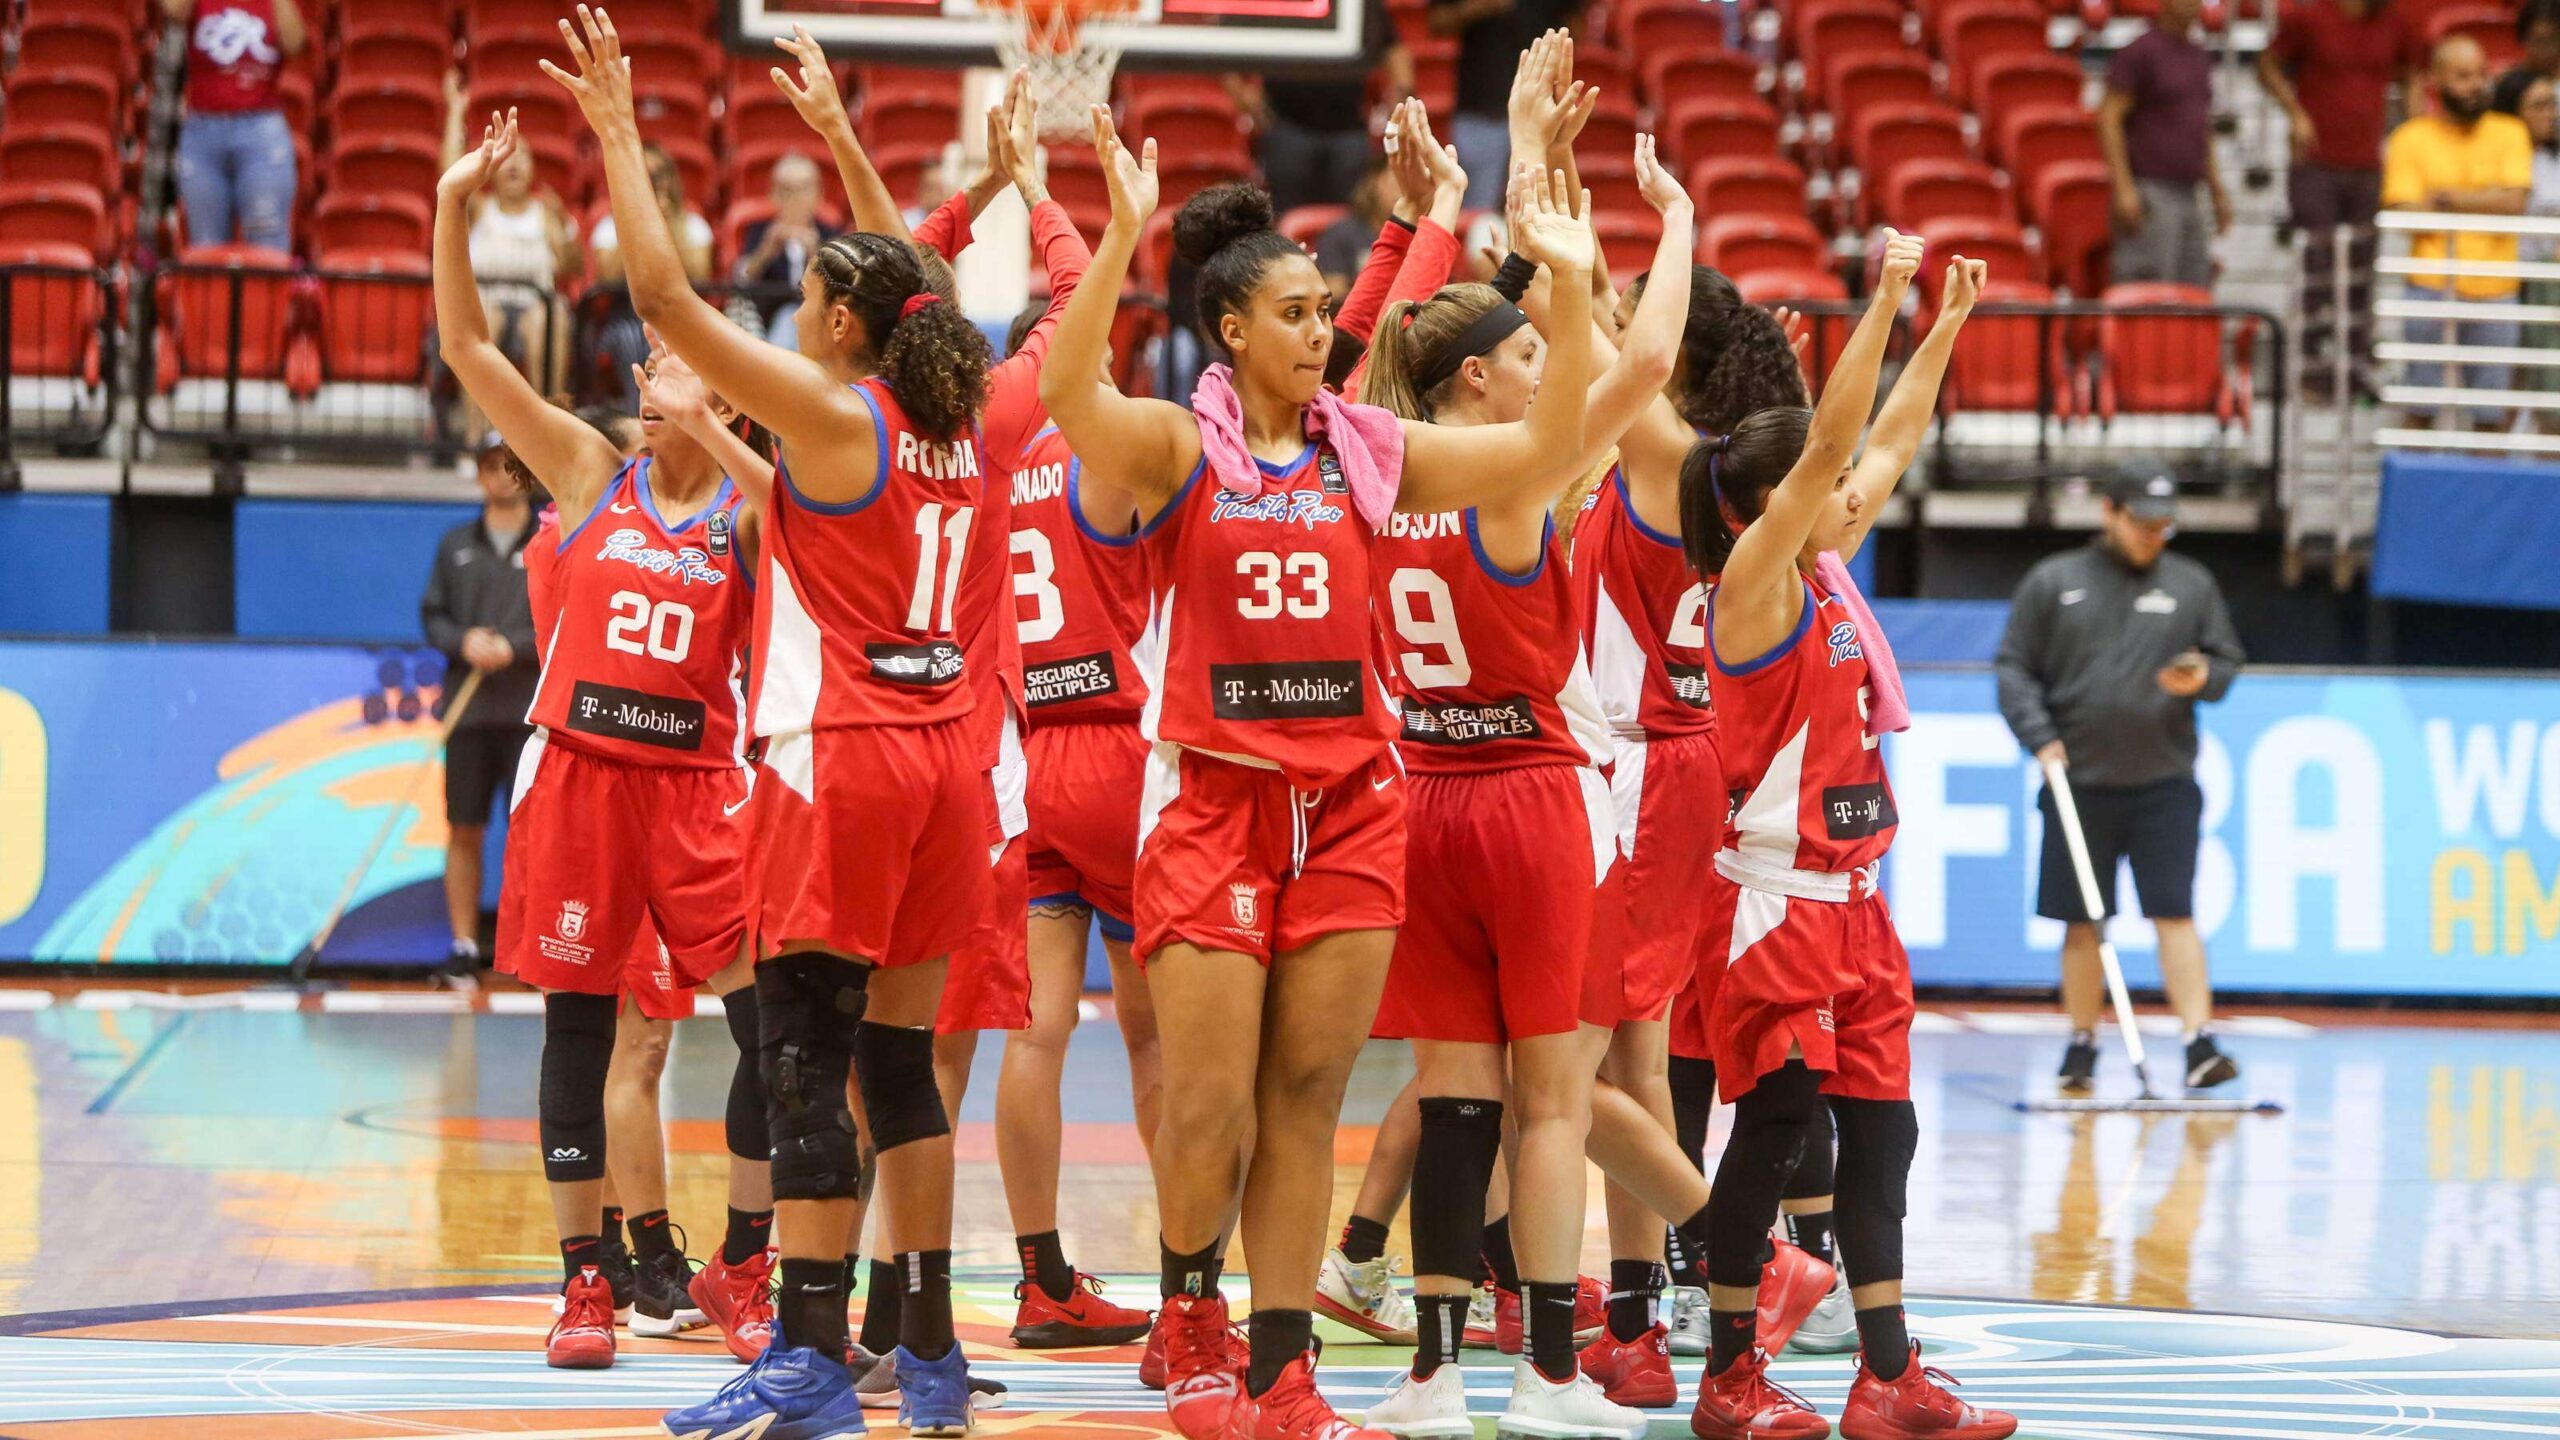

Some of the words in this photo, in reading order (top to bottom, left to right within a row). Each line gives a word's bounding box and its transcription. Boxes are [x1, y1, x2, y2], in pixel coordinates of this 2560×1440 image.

[1211, 487, 1288, 522] Puerto
[1287, 489, 1344, 531] Rico
[597, 528, 675, 573] Puerto
[669, 546, 727, 585] Rico
[904, 502, 975, 633] 11
[1236, 551, 1331, 619] 33
[606, 589, 695, 664] 20
[1388, 568, 1473, 690] 9
[1024, 673, 1111, 703] MULTIPLES
[1026, 659, 1101, 688] SEGUROS
[1440, 705, 1519, 726] SEGUROS
